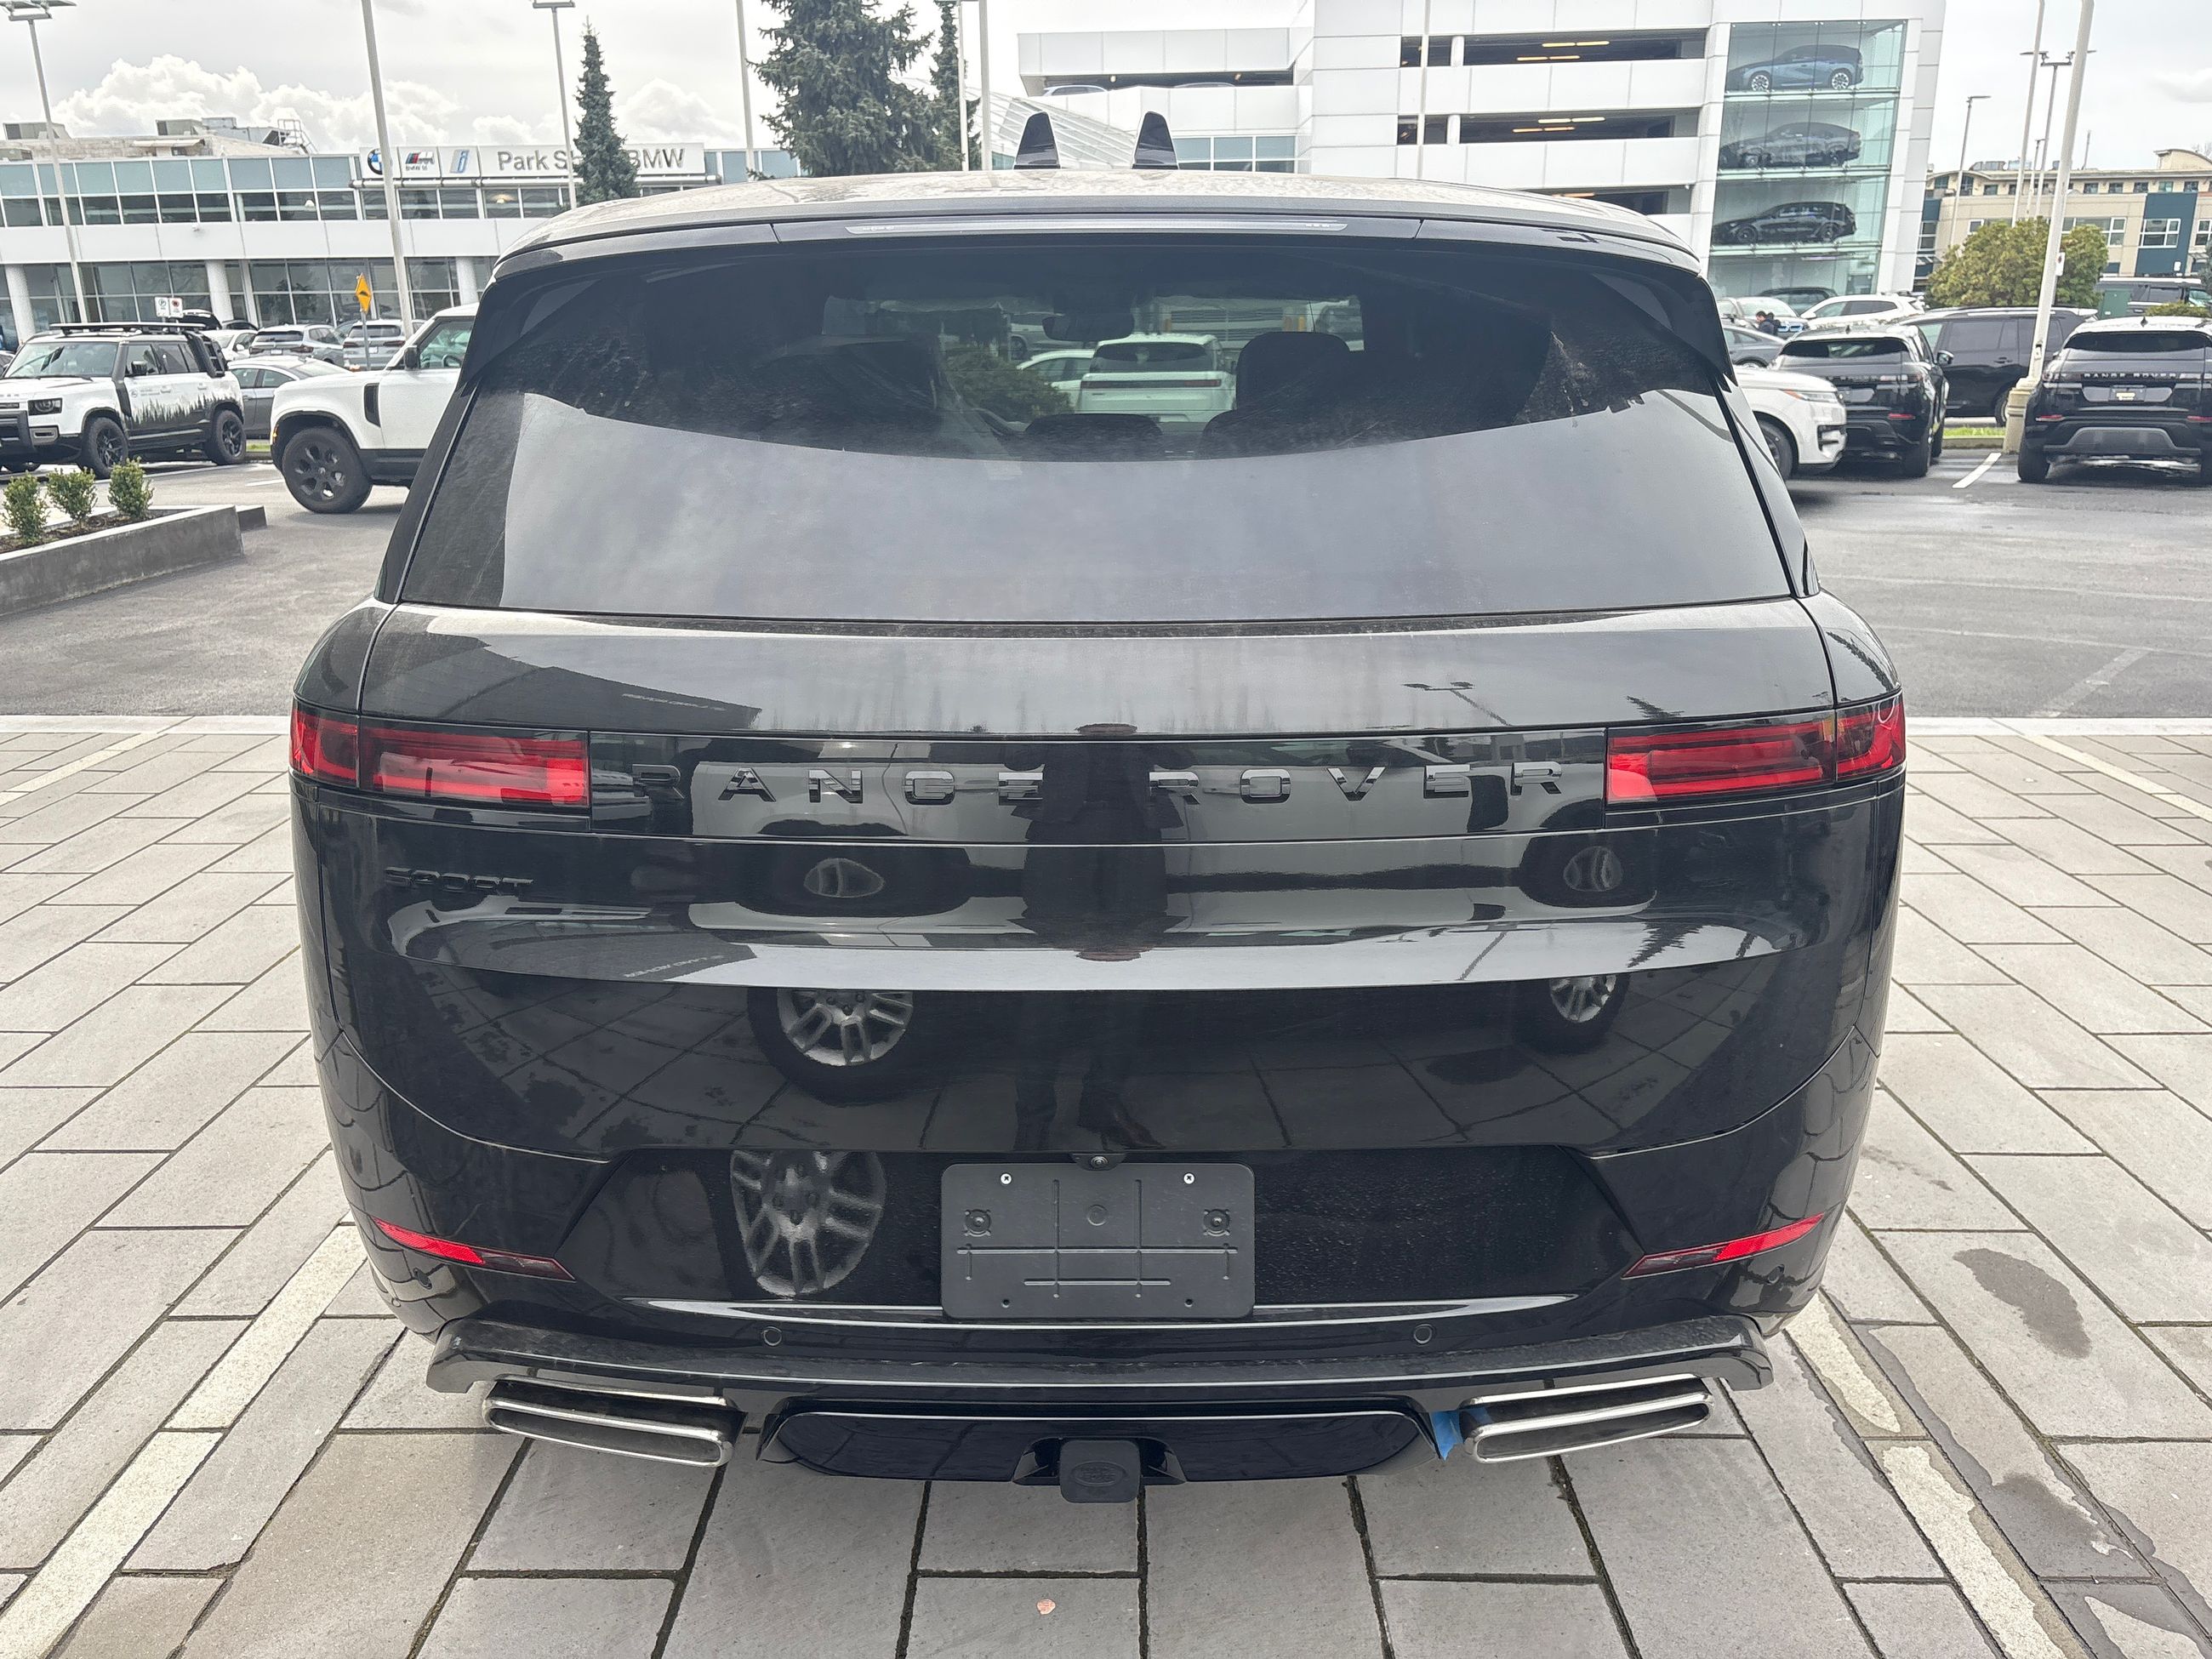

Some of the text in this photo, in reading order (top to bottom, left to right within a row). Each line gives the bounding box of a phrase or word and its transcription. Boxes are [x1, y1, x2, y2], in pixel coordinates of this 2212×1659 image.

[498, 150, 550, 170] Park
[626, 148, 685, 168] BMW
[632, 761, 1563, 807] RANGE ROVER
[385, 866, 534, 896] SPORT
